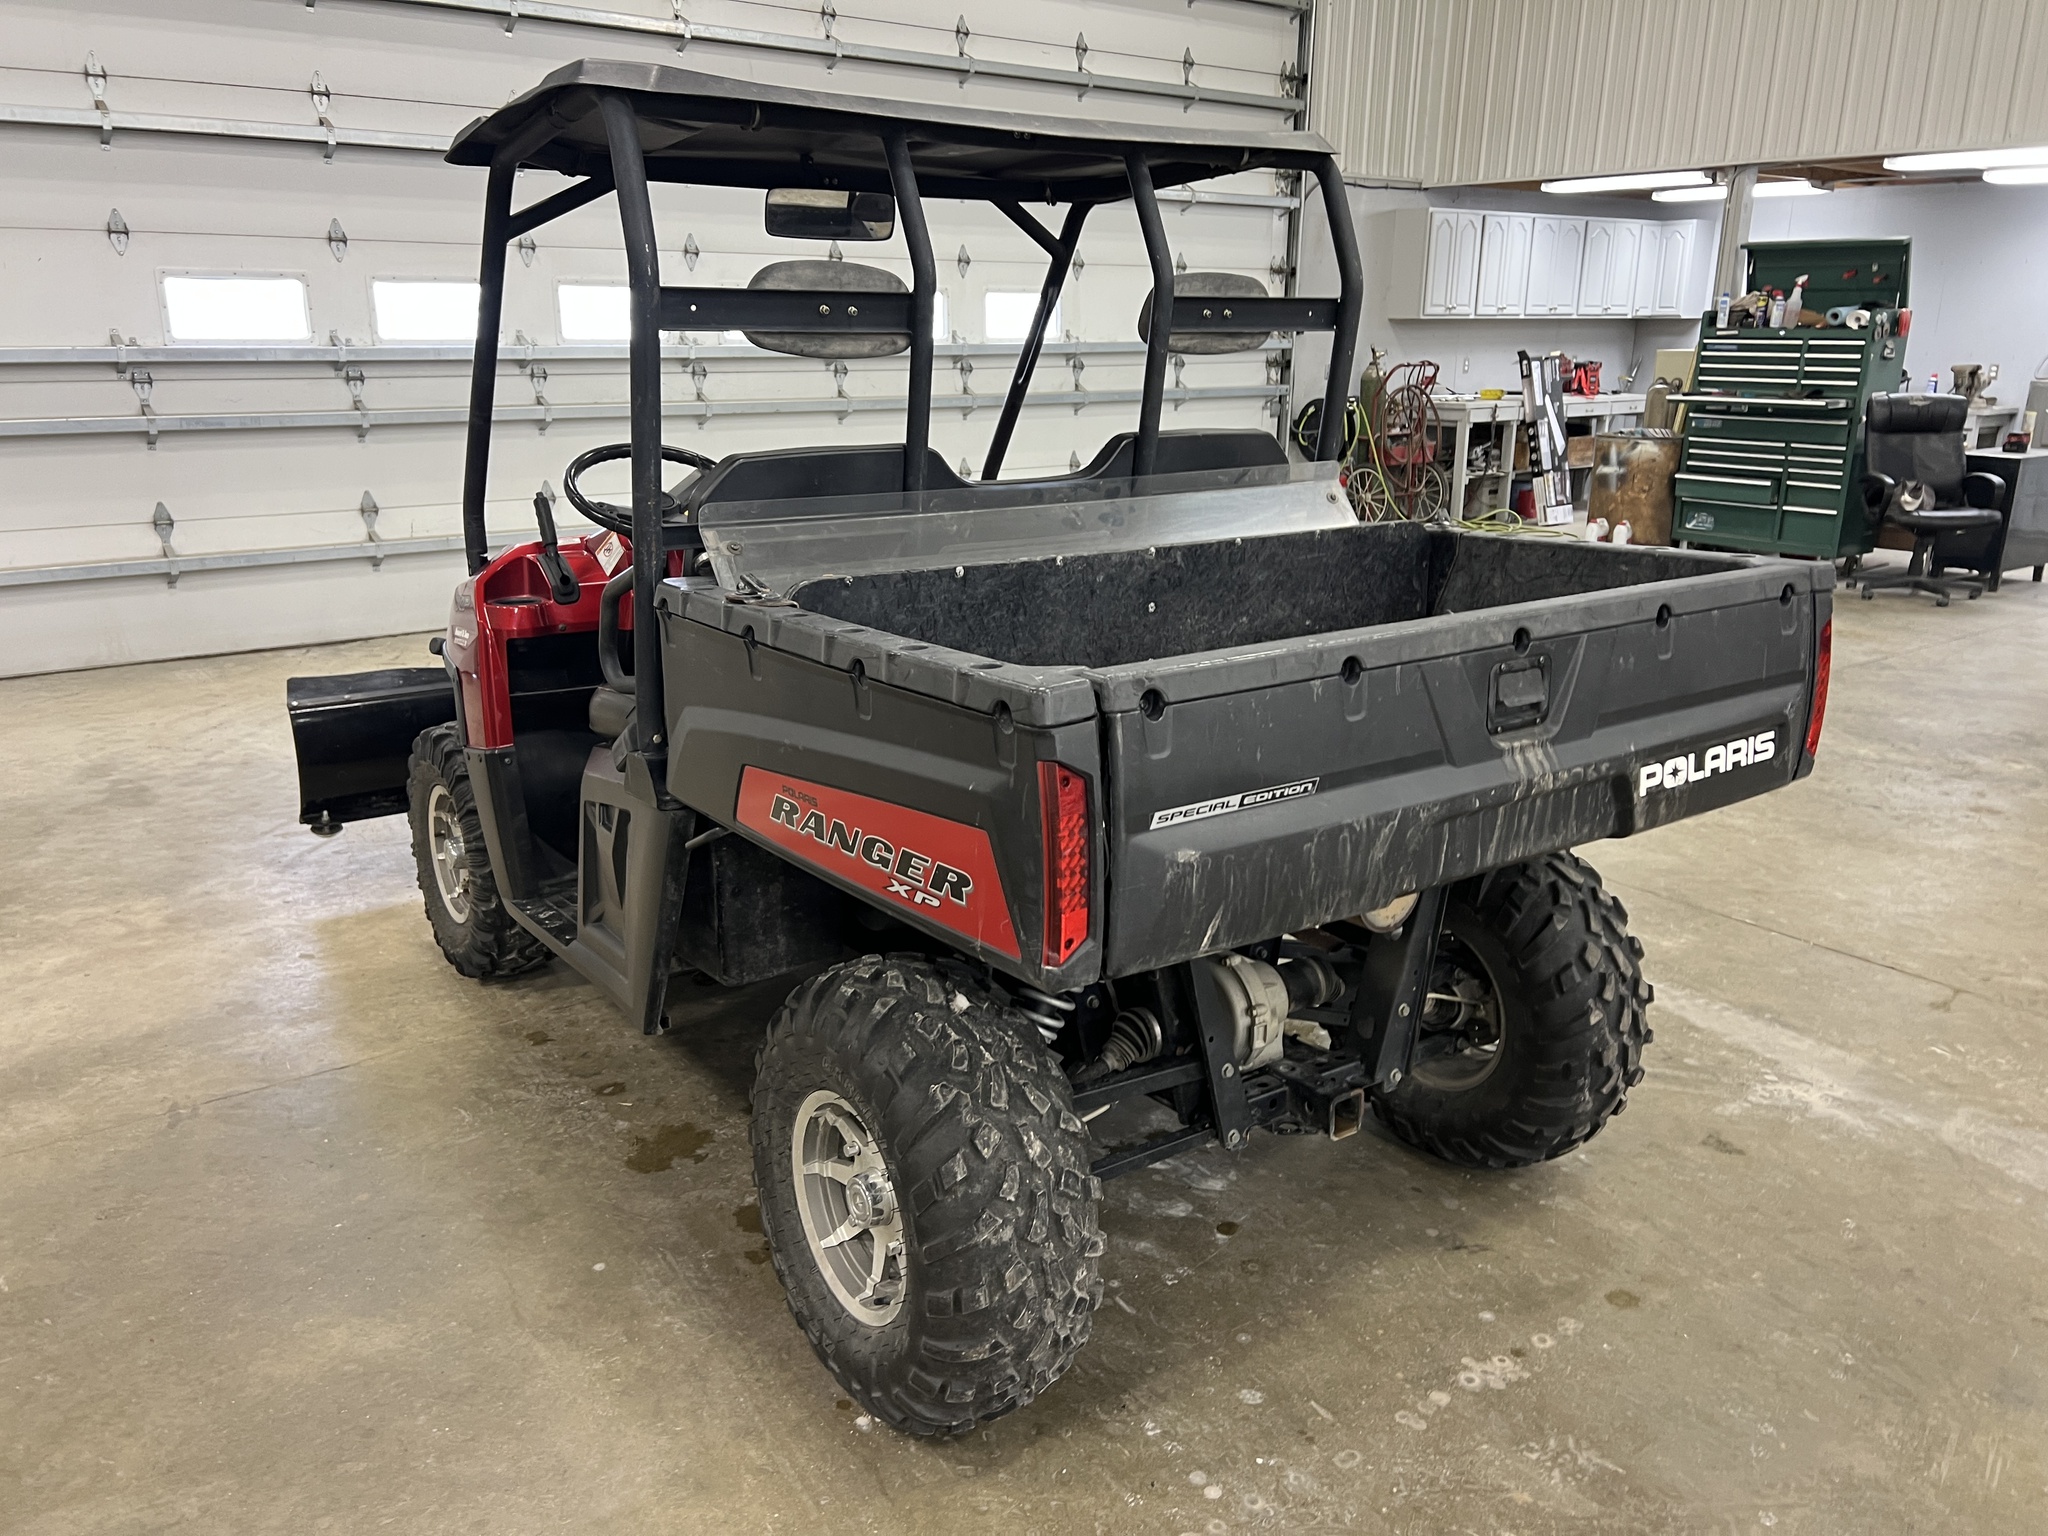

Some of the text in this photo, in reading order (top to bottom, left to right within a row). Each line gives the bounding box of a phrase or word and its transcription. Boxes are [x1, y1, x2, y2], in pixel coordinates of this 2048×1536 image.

[1639, 730, 1775, 797] POLARIS
[782, 784, 818, 807] POLARIS
[1156, 782, 1313, 825] SPECIAL EDITION
[770, 793, 974, 907] RANGER
[884, 877, 942, 909] XP
